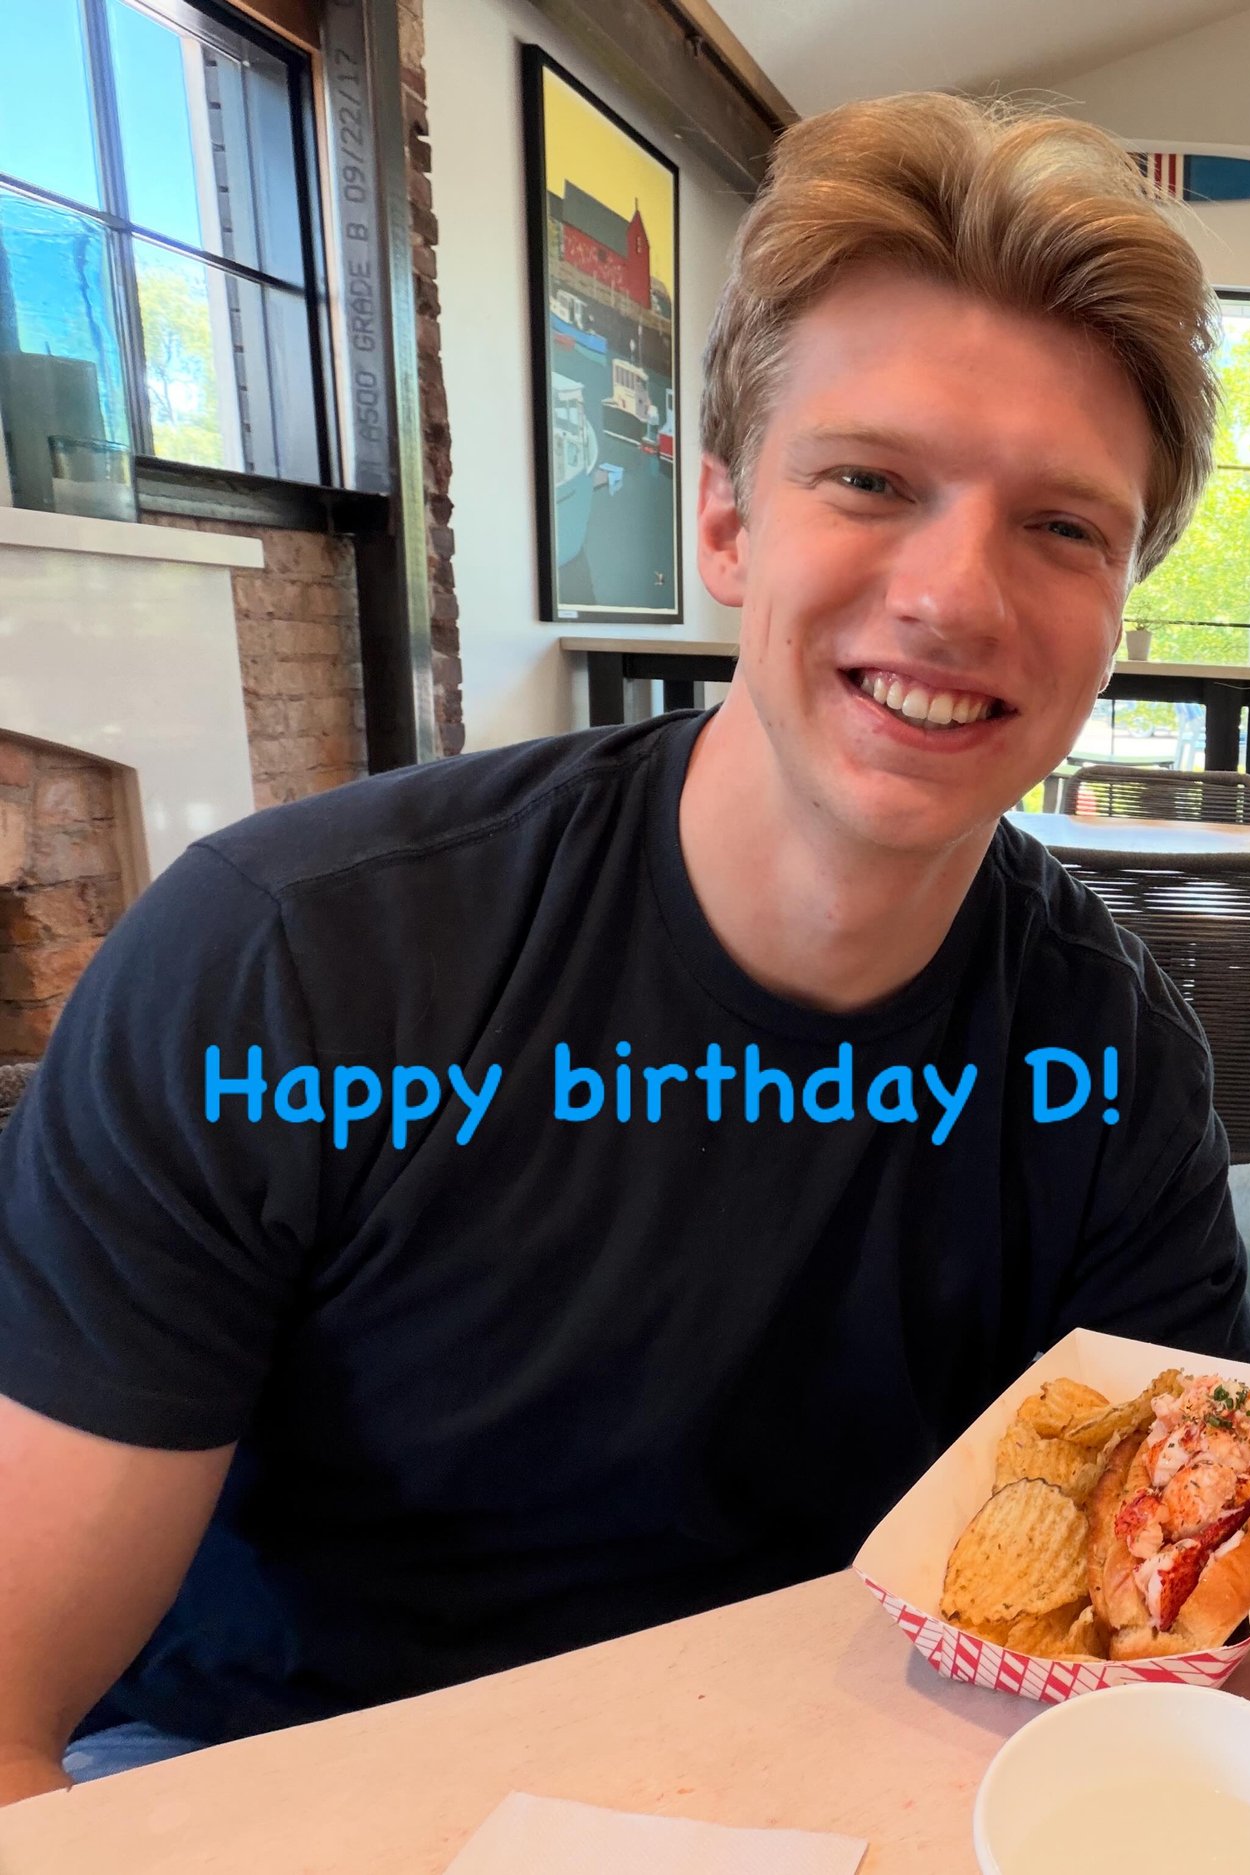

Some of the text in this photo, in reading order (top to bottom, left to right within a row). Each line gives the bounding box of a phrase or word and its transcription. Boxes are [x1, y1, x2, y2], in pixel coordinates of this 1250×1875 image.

[334, 48, 366, 204] 09/22/17
[347, 222, 368, 241] B
[350, 261, 376, 352] GRADE
